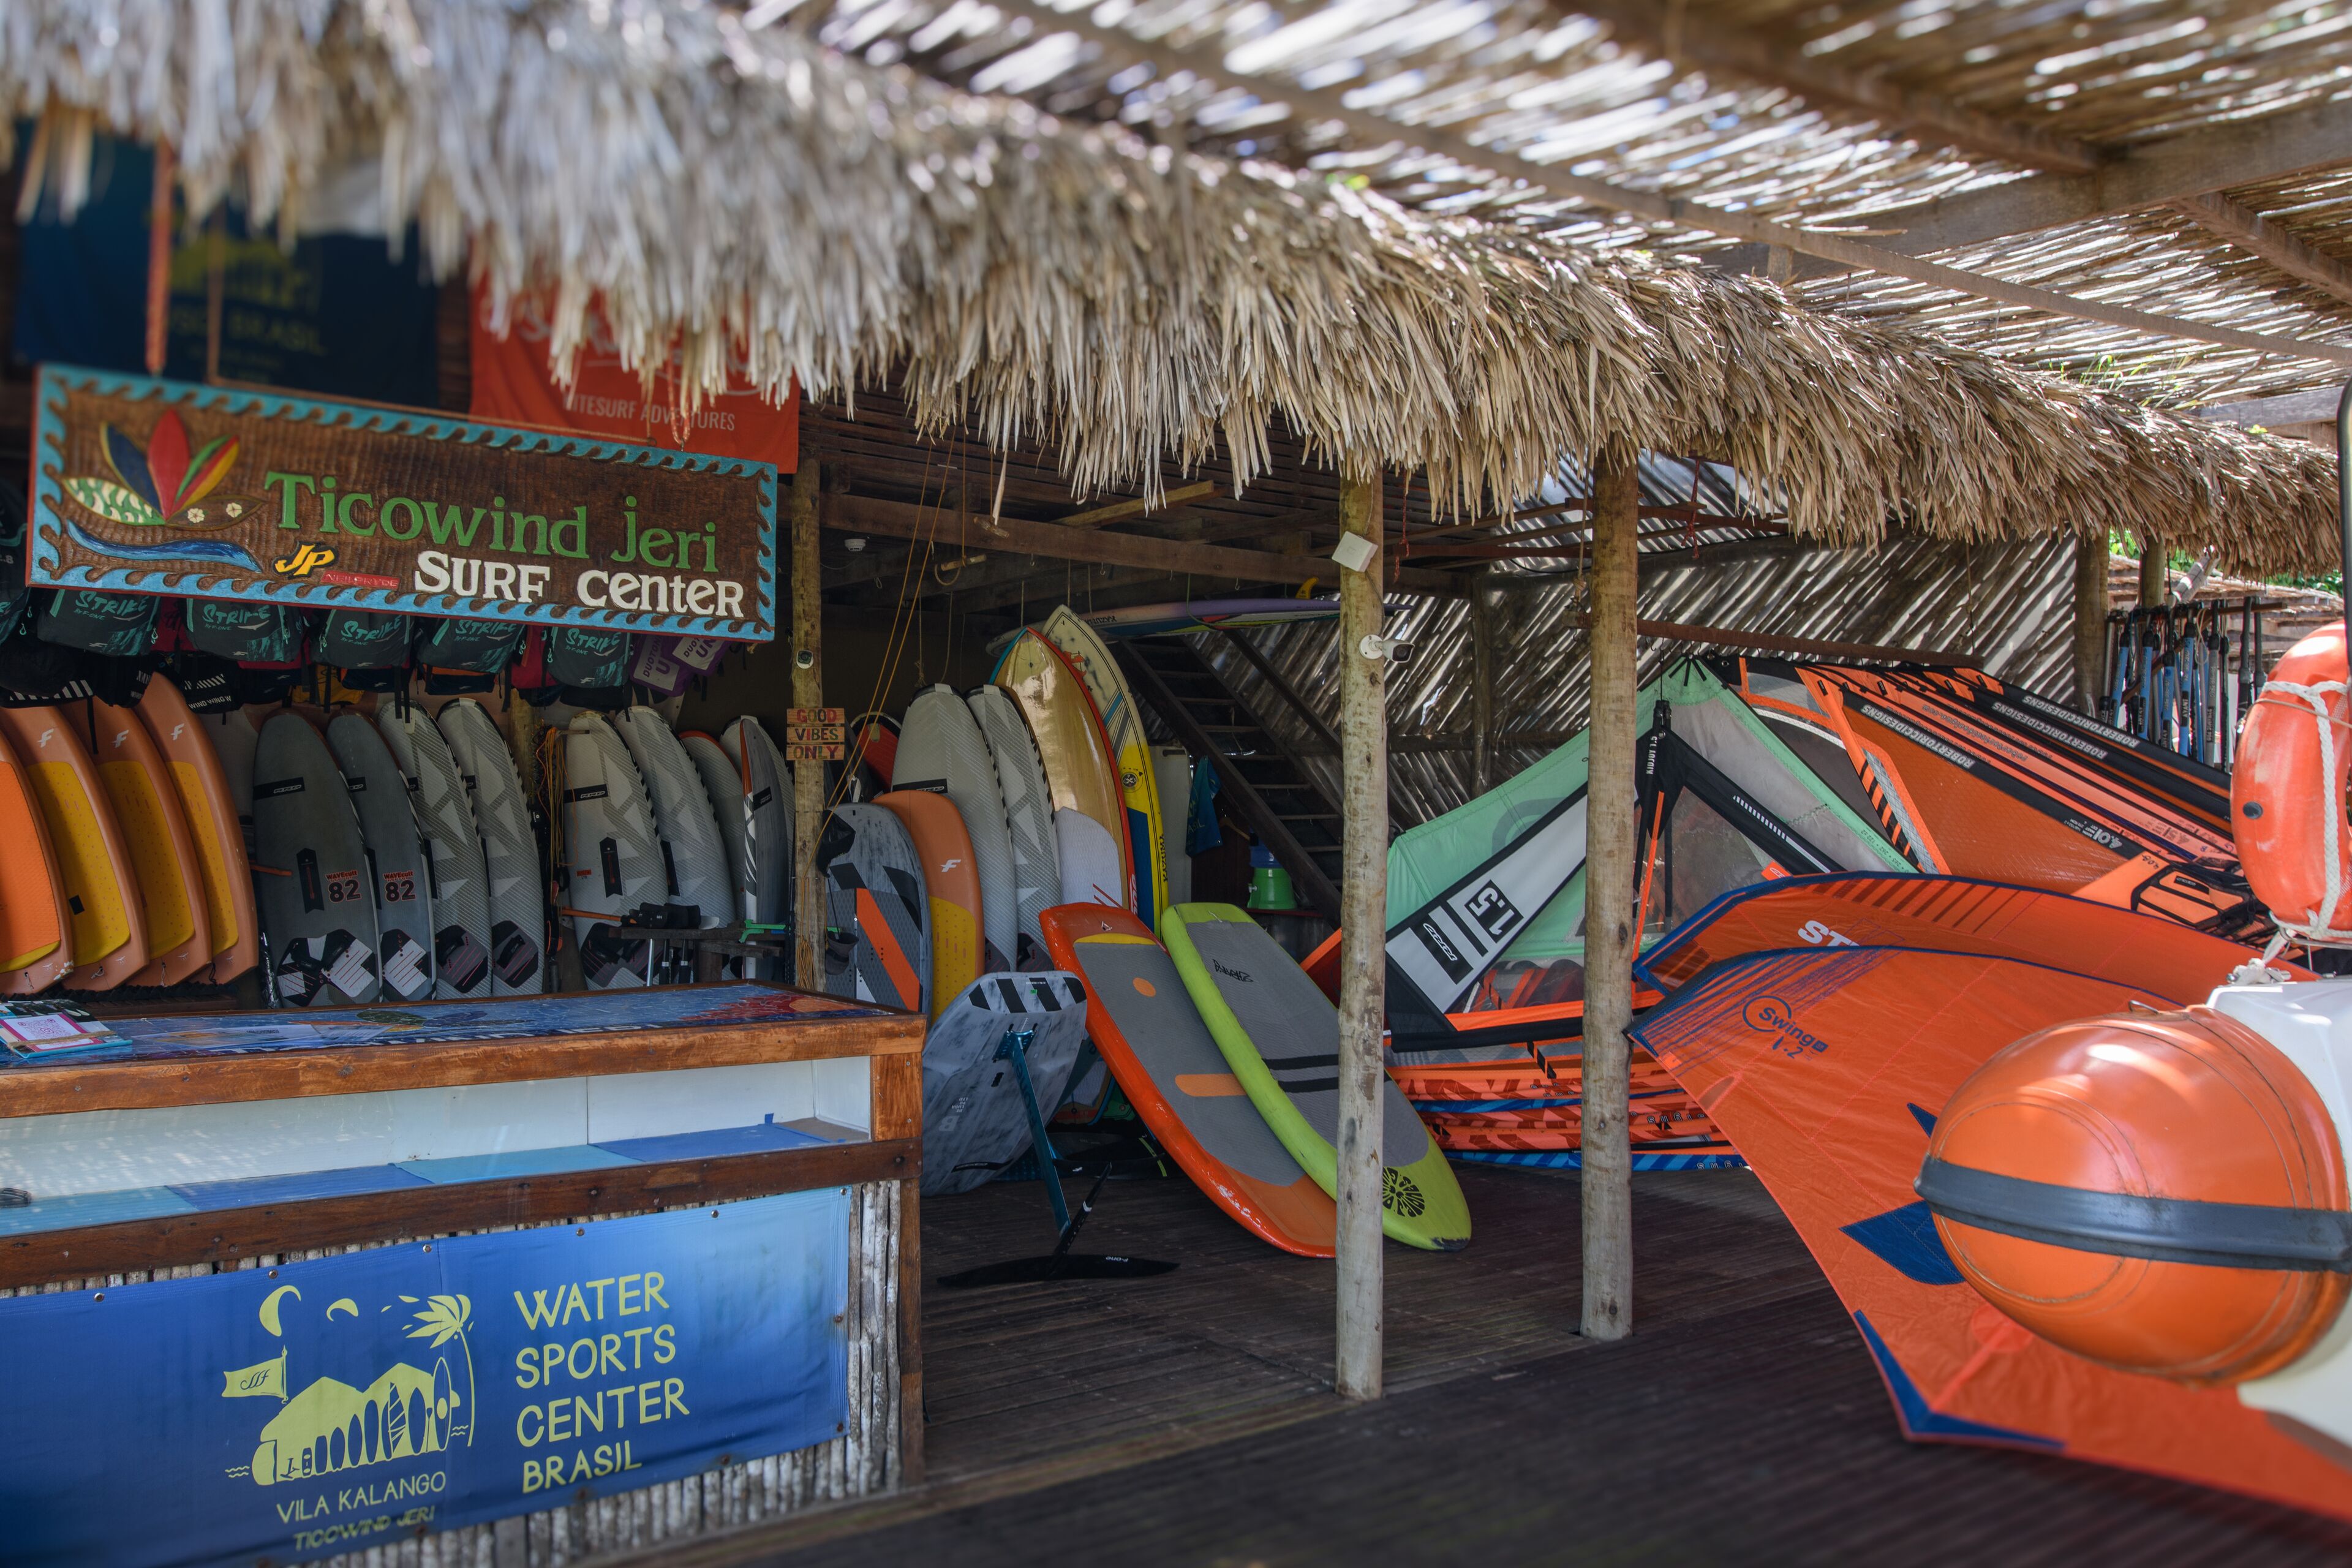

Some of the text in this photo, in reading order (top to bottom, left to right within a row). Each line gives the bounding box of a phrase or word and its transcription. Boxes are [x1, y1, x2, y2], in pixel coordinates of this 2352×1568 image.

[564, 394, 636, 420] ITESURF
[264, 470, 719, 572] Ticowind jeri
[273, 543, 336, 576] JP
[415, 550, 551, 602] SURF
[75, 590, 151, 617] STRIKE
[187, 699, 208, 709] WIND
[208, 696, 225, 704] WING
[796, 709, 837, 723] GOOD
[793, 745, 839, 759] ONLY
[795, 728, 839, 741] VIBES
[1860, 704, 1976, 769] ROBERTORICCIDESIGNS
[328, 880, 361, 902] 82
[385, 880, 416, 902] 82
[1469, 887, 1515, 935] 1.5
[1758, 1006, 1817, 1047] Swing
[514, 1272, 669, 1330] WATER
[516, 1324, 676, 1389] SPORTS
[516, 1378, 690, 1447] CENTER
[522, 1440, 642, 1494] BRASIL
[276, 1471, 446, 1523] VILA KALANGO
[293, 1505, 435, 1551] TICOWIND JERI
